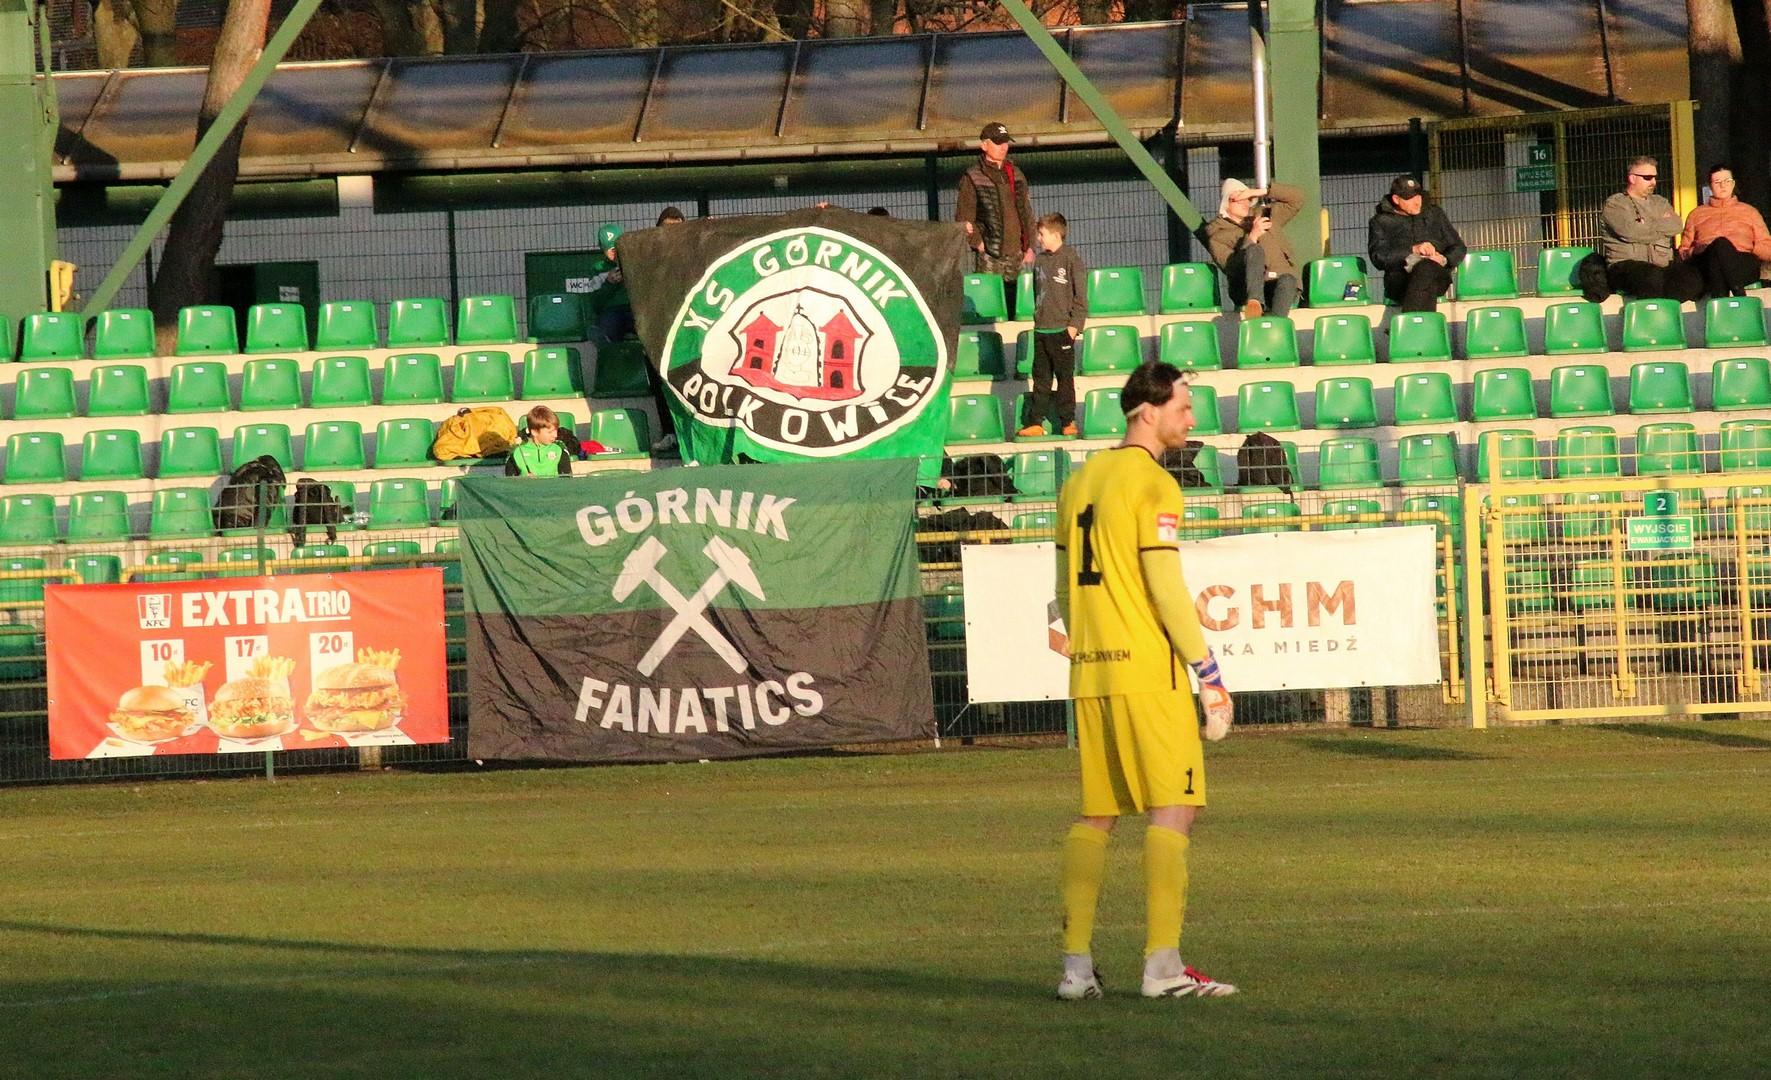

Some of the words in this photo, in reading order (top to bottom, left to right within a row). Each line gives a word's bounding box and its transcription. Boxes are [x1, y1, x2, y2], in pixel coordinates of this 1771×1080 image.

[1533, 149, 1547, 161] 16
[752, 234, 909, 310] GÓRNIK
[569, 281, 583, 289] WC
[1656, 497, 1667, 511] 2
[575, 486, 797, 547] GÓRNIK
[1633, 522, 1687, 534] WYJŚCIE
[1077, 503, 1103, 586] 1
[181, 588, 307, 628] EXTRA
[305, 590, 351, 617] TRIO
[1195, 580, 1357, 632] GHM
[145, 619, 166, 627] KFC
[151, 642, 172, 662] 10
[235, 638, 255, 658] 17
[319, 634, 343, 655] 20
[183, 698, 199, 707] FC
[574, 670, 824, 736] FANATICS
[1183, 767, 1195, 795] 1
